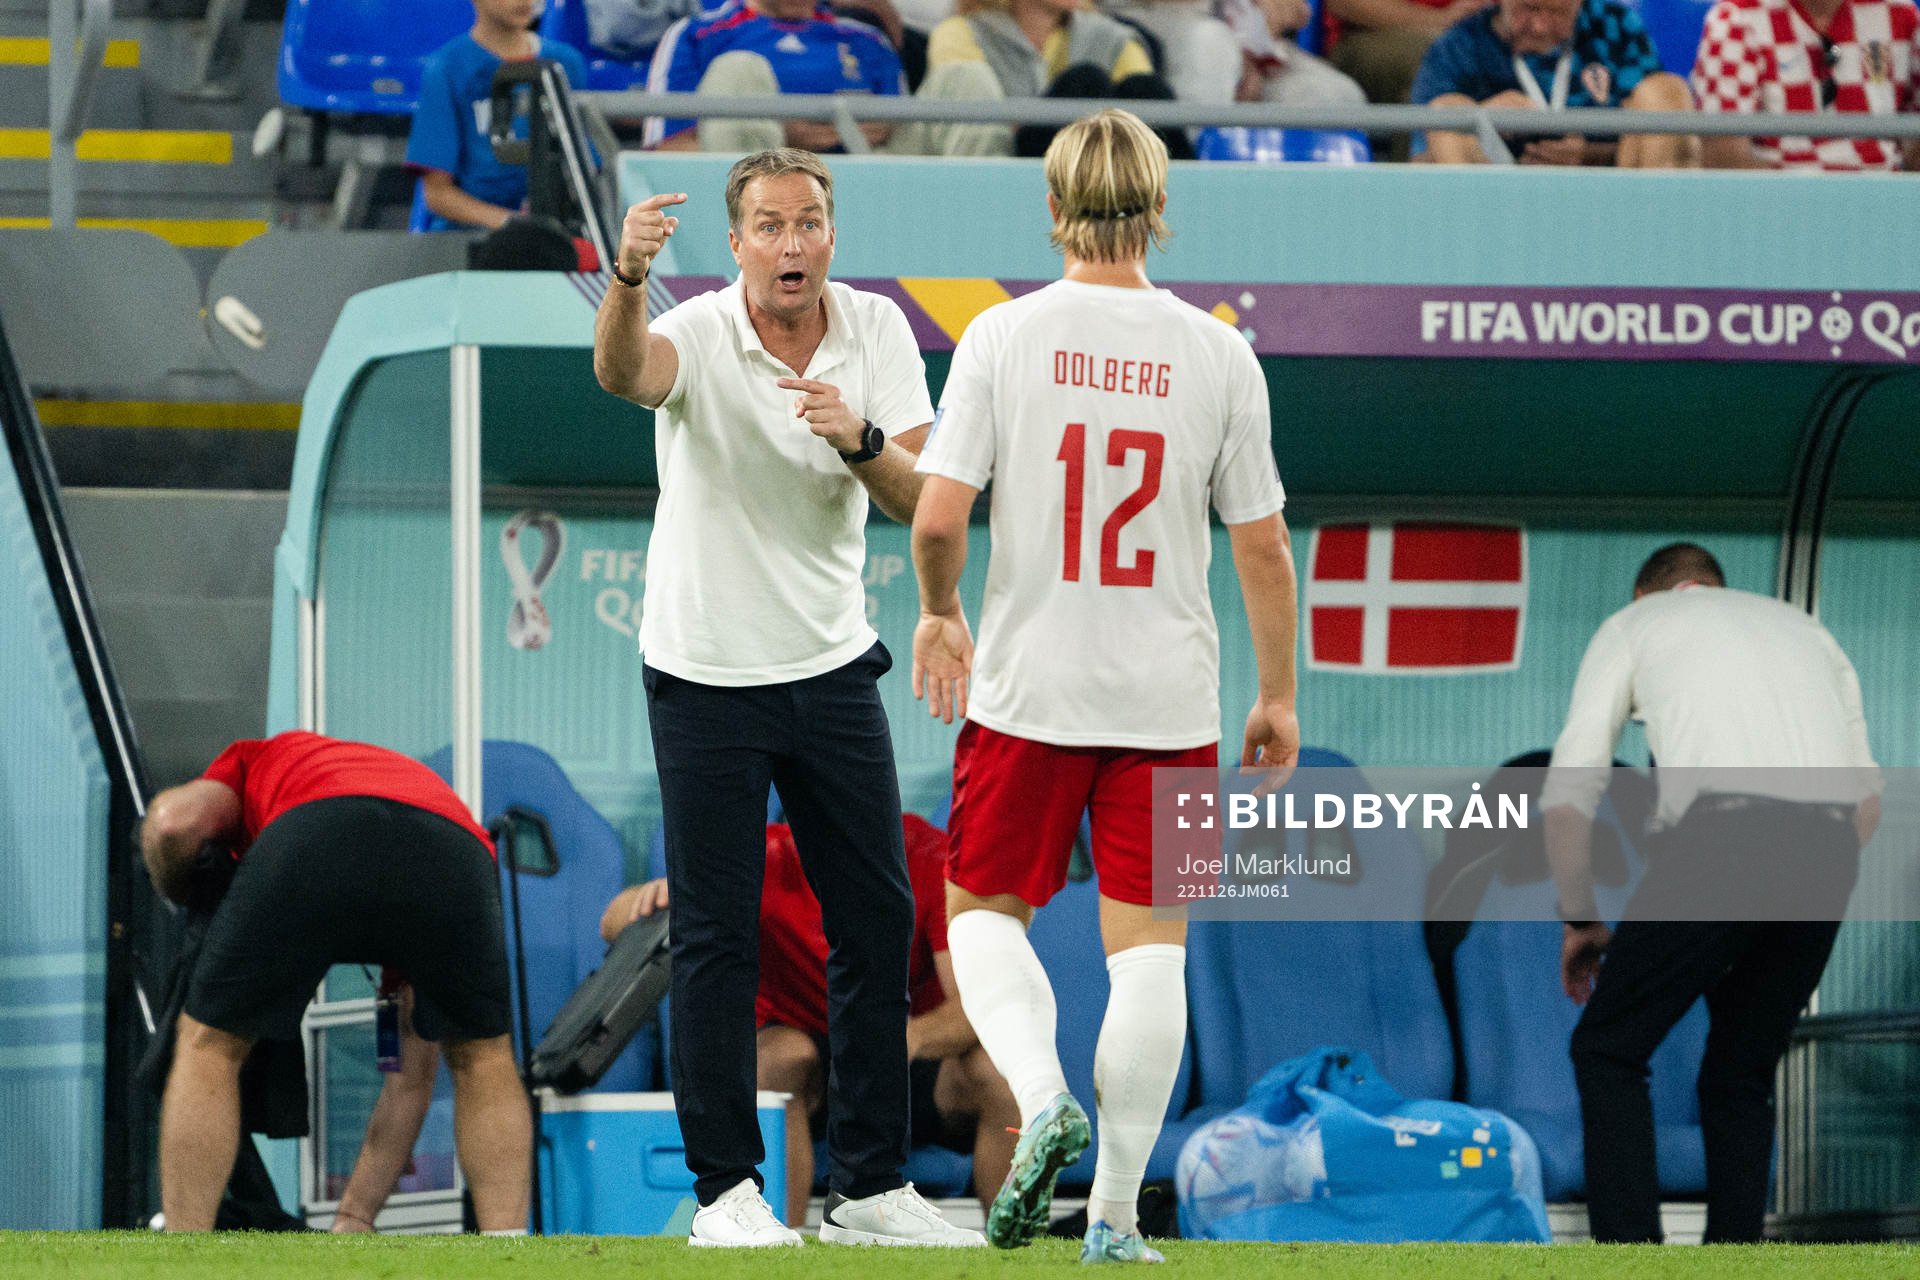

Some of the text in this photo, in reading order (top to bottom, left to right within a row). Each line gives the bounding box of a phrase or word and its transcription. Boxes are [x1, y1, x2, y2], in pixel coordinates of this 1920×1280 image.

[1421, 300, 1528, 343] FIFA
[1531, 301, 1711, 344] WORLD
[1718, 303, 1813, 345] CUP
[1055, 350, 1171, 397] DOLBERG
[1056, 423, 1165, 587] 12
[581, 549, 647, 581] FIF
